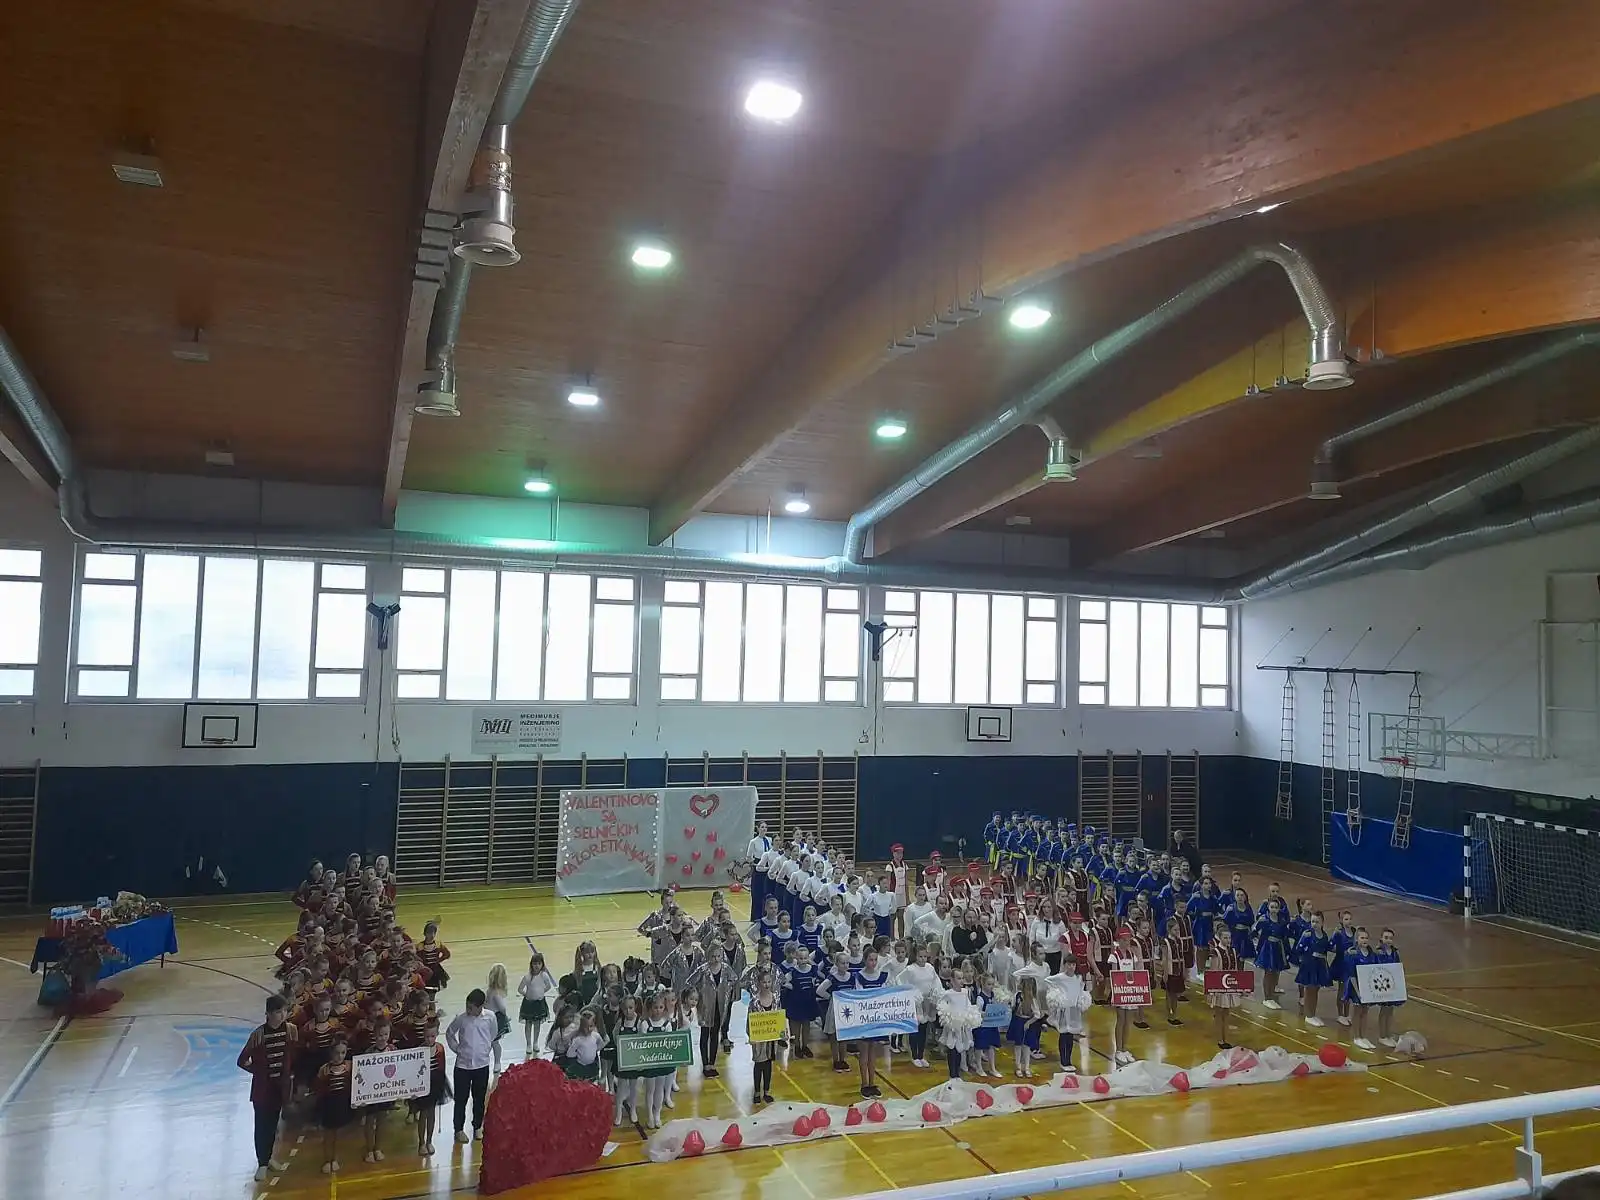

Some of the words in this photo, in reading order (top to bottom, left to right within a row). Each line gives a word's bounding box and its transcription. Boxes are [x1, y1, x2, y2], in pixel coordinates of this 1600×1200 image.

[567, 794, 657, 809] VALENTINOVO
[858, 996, 911, 1011] Mažoretkinje
[859, 1011, 881, 1024] Male
[883, 1009, 915, 1022] Subotice
[627, 1037, 683, 1050] Mažoretkinje
[357, 1051, 425, 1067] MAŽORETKINJE
[356, 1094, 372, 1102] SVETI
[373, 1090, 398, 1099] MARTIN
